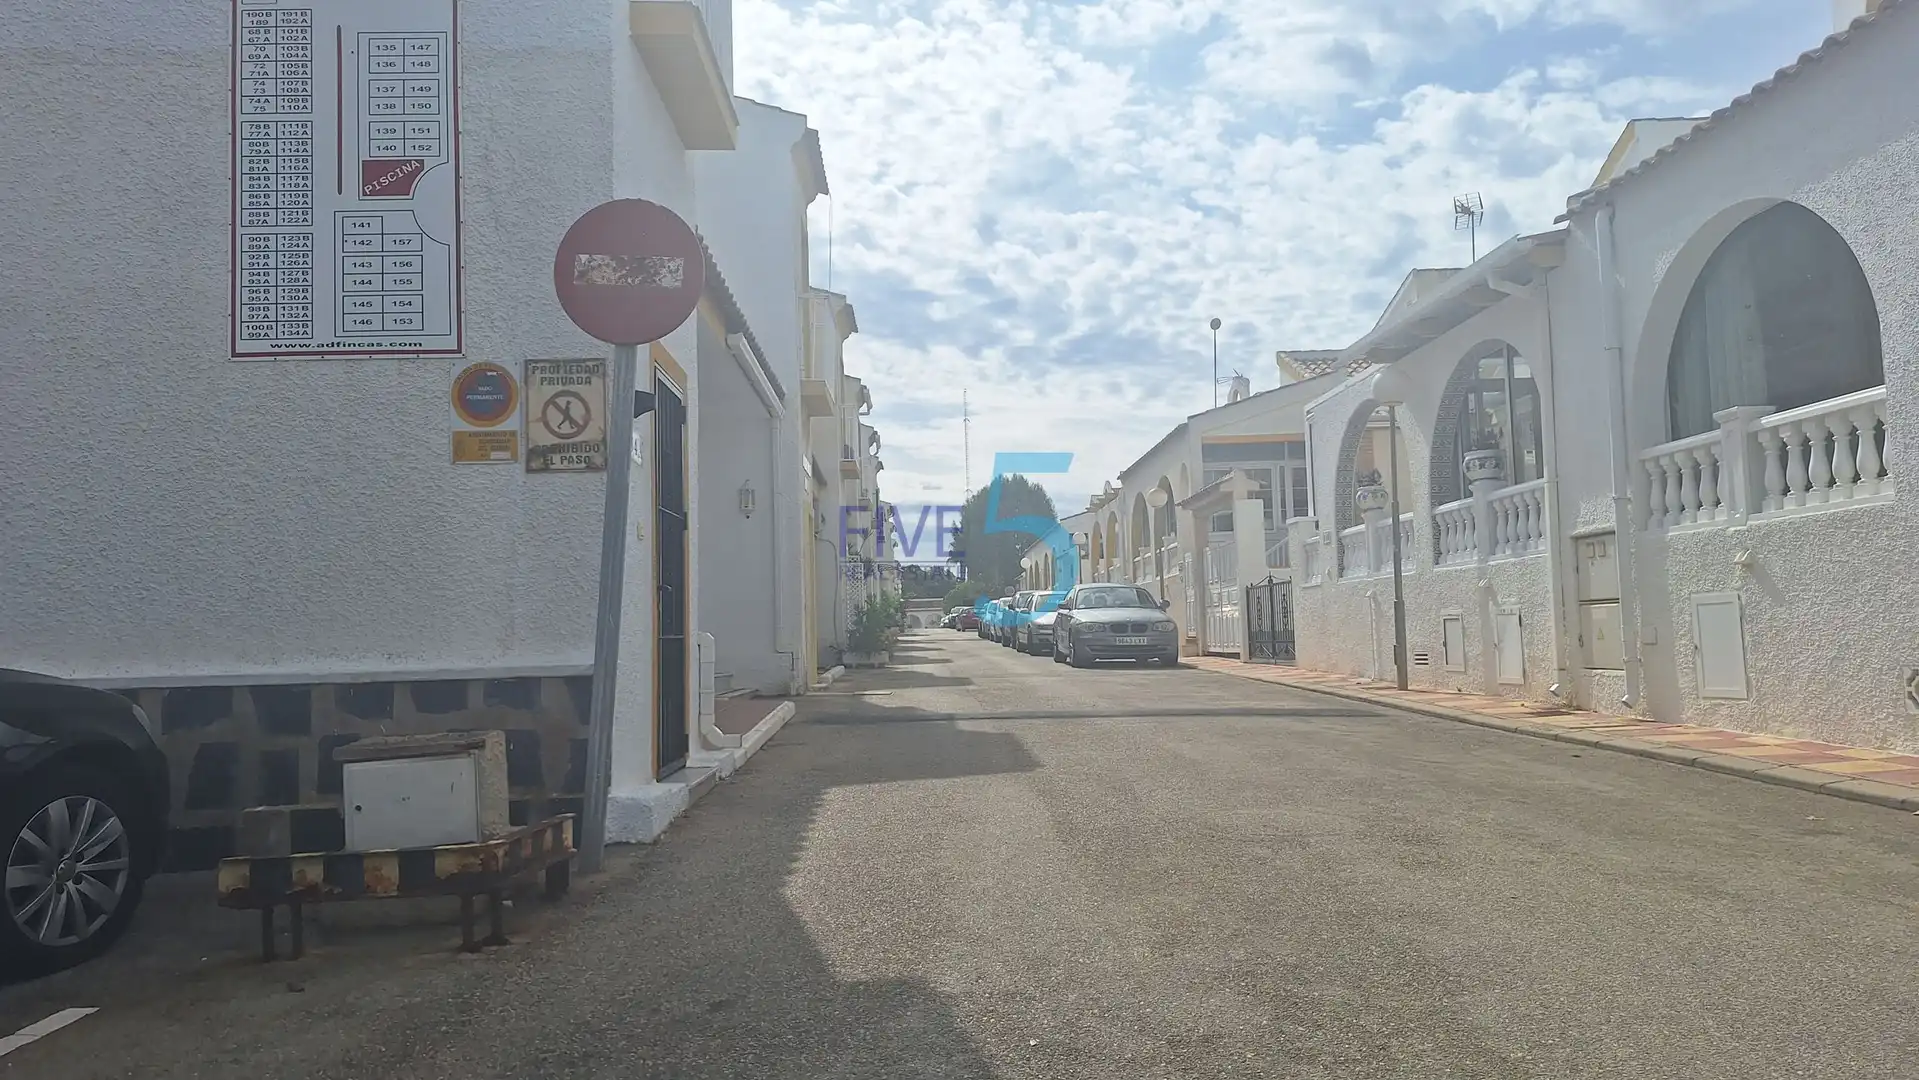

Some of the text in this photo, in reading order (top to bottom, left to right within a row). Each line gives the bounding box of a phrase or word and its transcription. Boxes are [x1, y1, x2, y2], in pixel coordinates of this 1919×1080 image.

[364, 160, 420, 195] PISCINA
[532, 364, 600, 374] PROPIEDAD
[540, 377, 592, 386] PRIVADA
[543, 455, 591, 465] EL PASO
